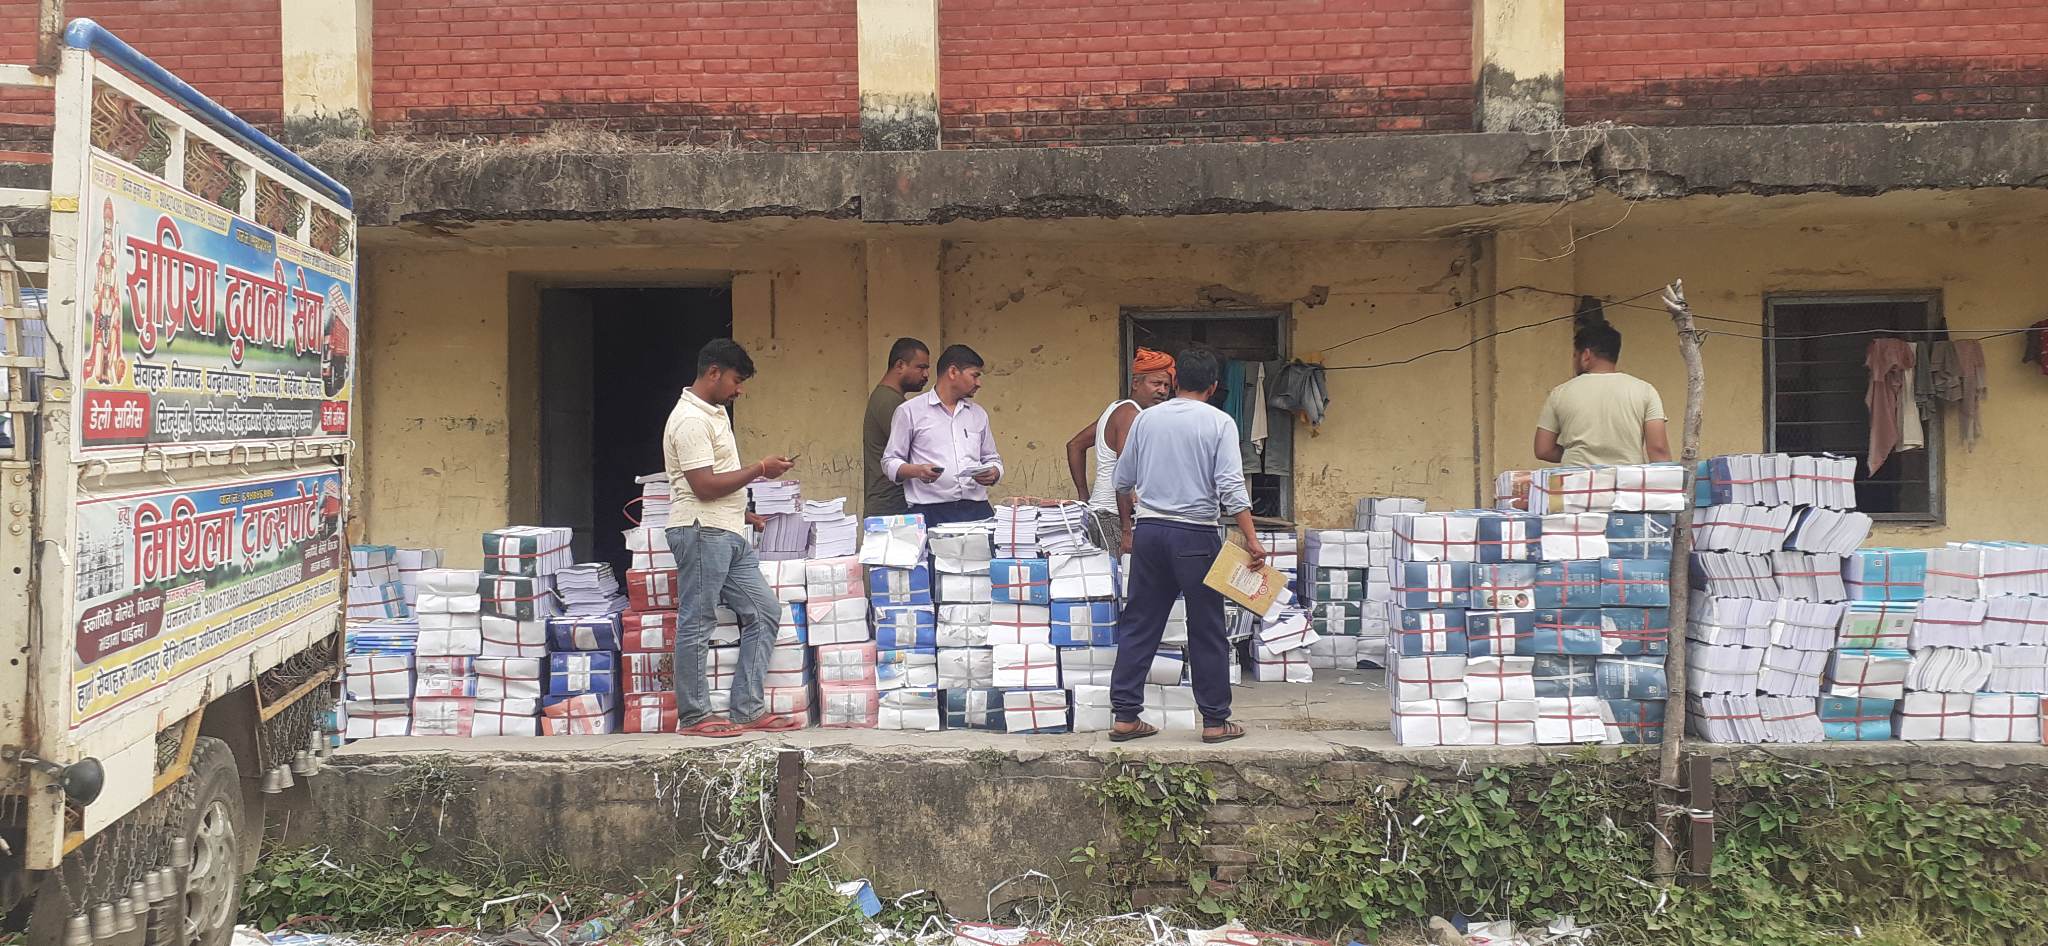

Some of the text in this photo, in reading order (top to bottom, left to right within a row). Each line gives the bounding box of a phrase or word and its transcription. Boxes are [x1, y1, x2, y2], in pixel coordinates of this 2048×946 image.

[126, 216, 324, 362] सुप्रिया ढुवानी सेवा
[90, 400, 112, 429] डेली
[133, 497, 236, 586] मिथिला
[241, 480, 319, 573] ट्रान्सपोर्ट
